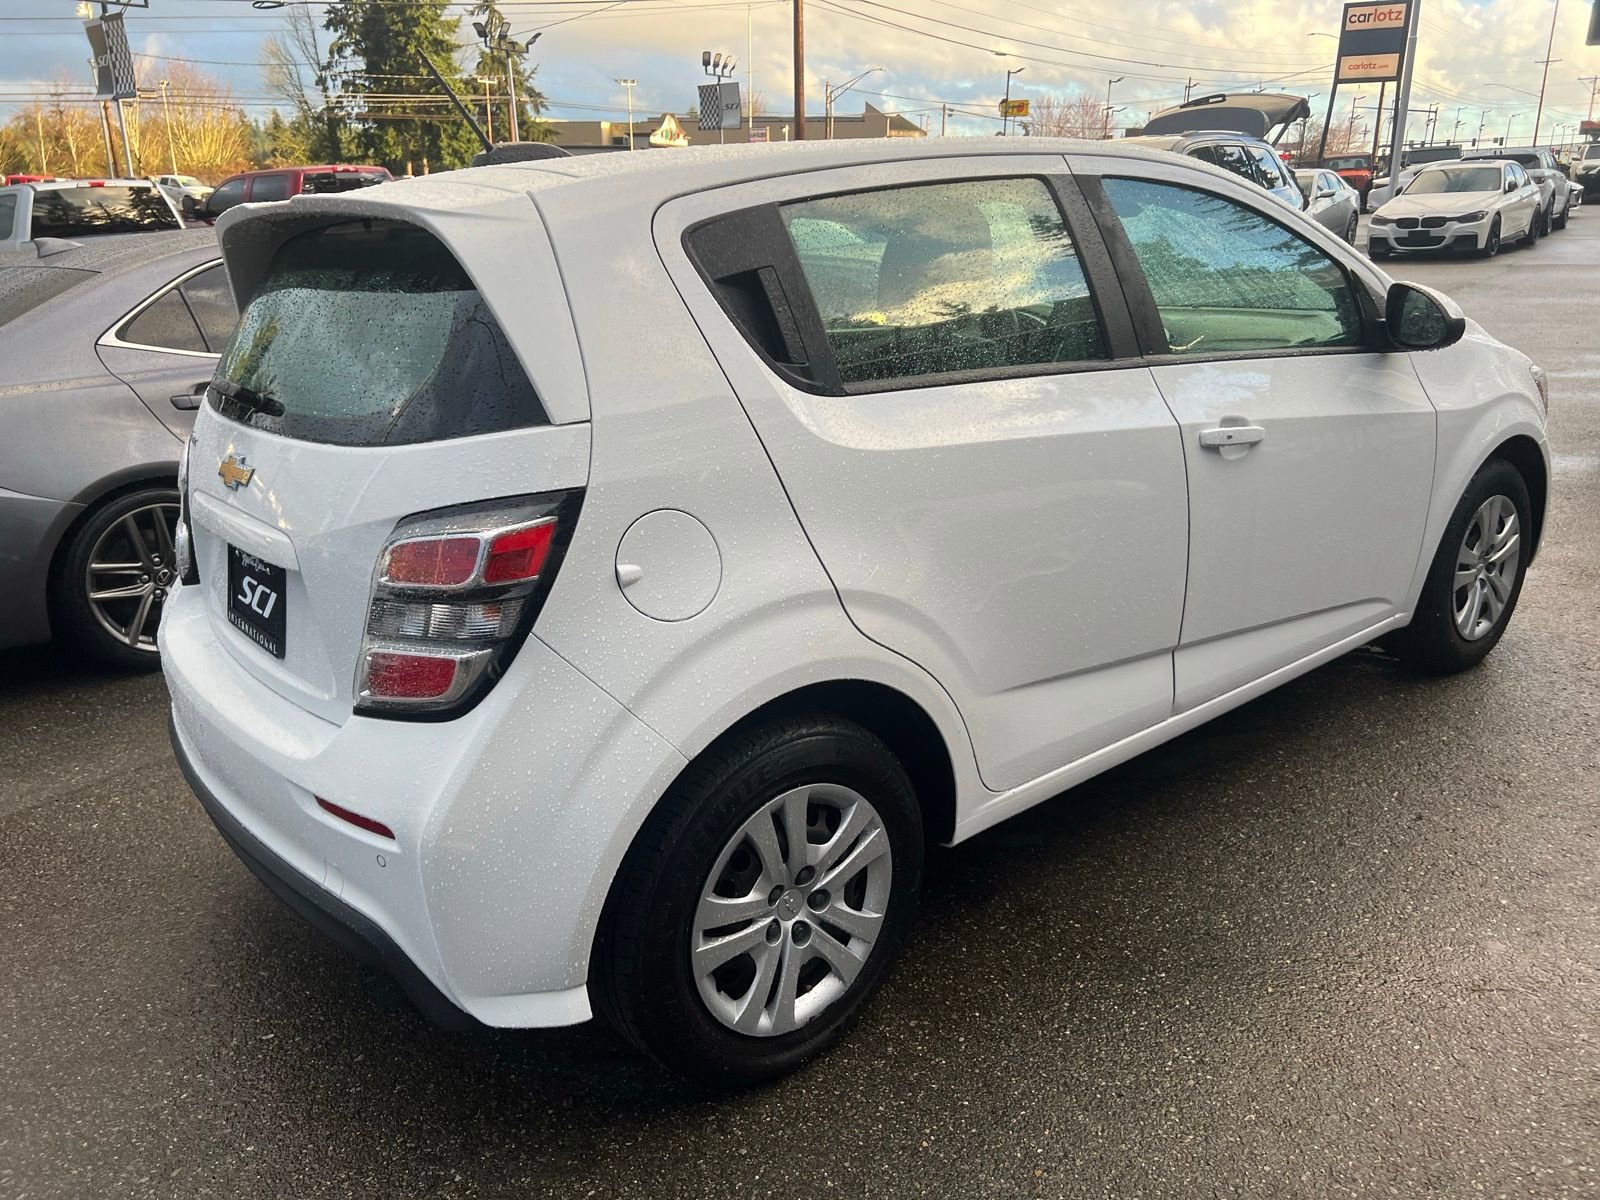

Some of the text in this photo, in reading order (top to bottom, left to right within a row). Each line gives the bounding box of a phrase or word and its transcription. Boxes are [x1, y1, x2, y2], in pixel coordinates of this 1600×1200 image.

[1348, 8, 1403, 24] carlotz
[237, 575, 278, 619] SCI
[228, 610, 278, 655] INTERNATIONAL
